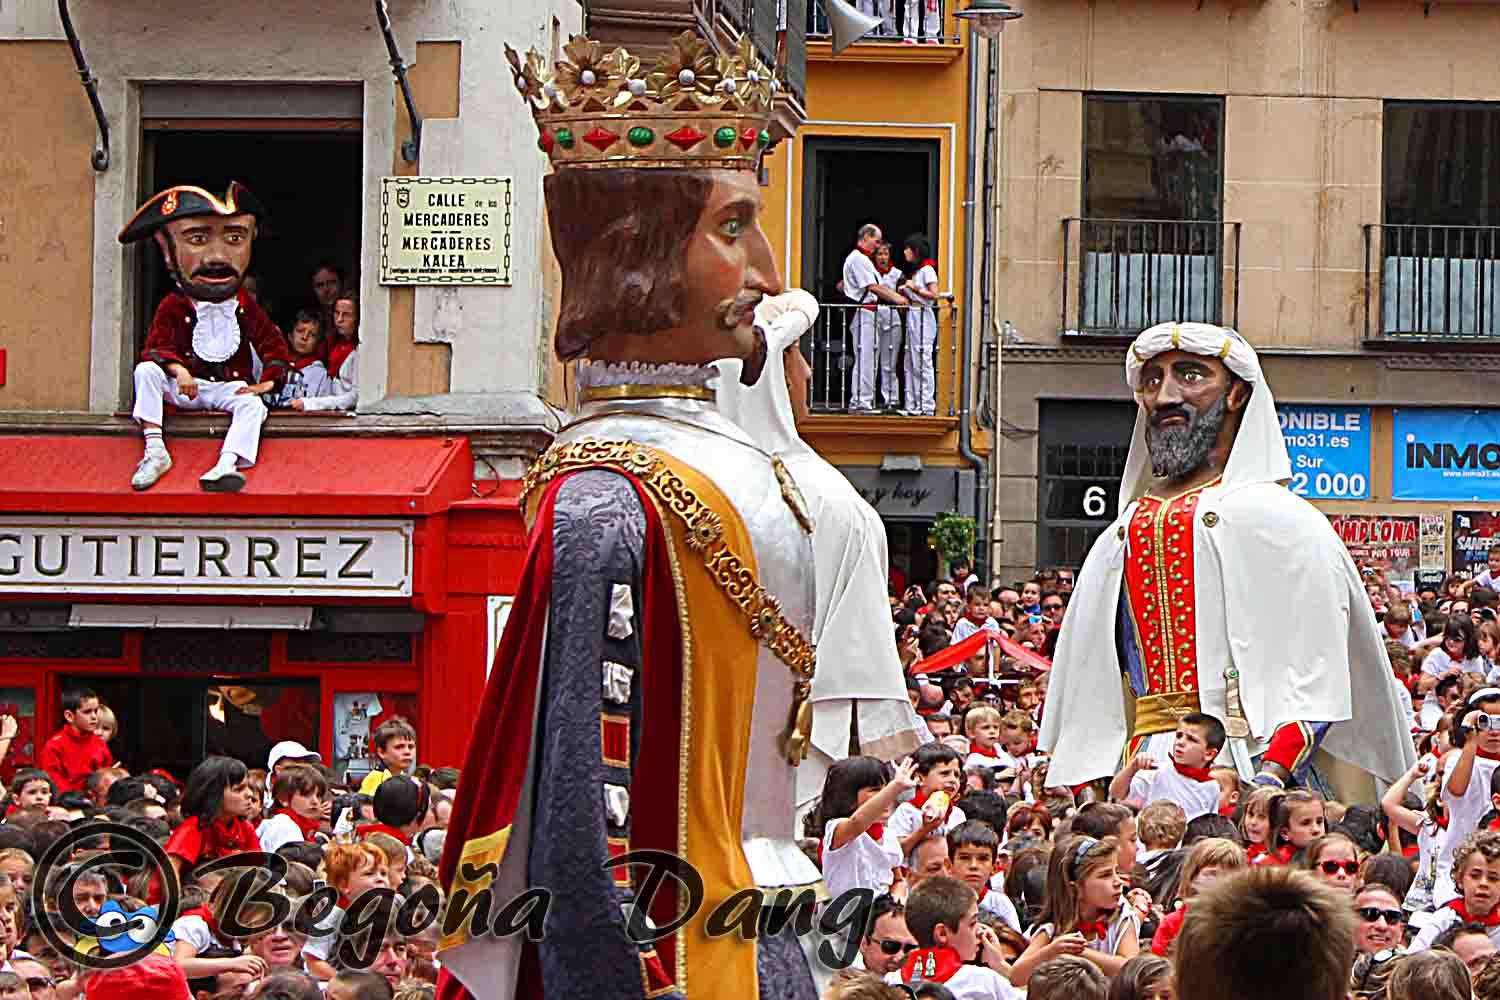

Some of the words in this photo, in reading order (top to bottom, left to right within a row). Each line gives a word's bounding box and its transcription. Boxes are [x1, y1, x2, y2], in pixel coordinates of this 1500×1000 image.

[428, 193, 465, 207] CALLE
[404, 213, 489, 226] MERCADERES
[402, 237, 491, 250] MERCADERES
[423, 254, 465, 268] KALEA
[1278, 412, 1361, 431] ONIBLE
[1284, 433, 1350, 448] mo31.es
[1296, 454, 1324, 468] Sur
[1315, 472, 1366, 496] 000
[1083, 485, 1107, 516] 6
[1332, 519, 1417, 543] AMPLONA
[0, 534, 374, 579] GUTIERREZ
